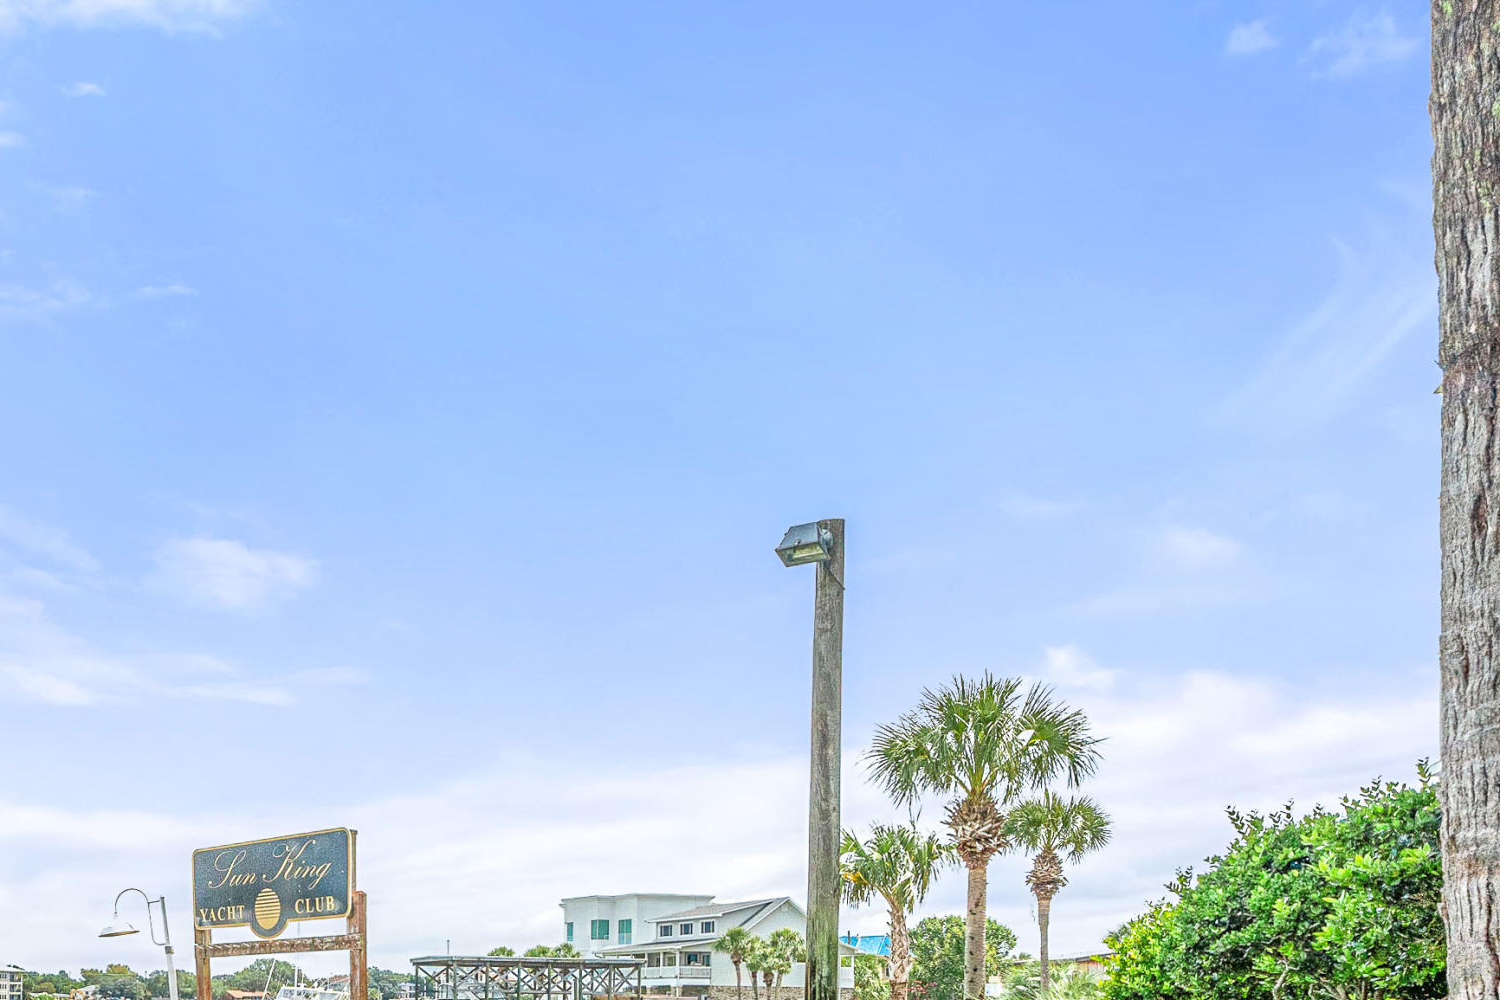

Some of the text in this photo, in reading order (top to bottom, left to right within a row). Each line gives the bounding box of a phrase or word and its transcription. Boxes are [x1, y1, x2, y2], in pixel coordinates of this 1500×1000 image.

[208, 839, 332, 890] Sun King
[200, 895, 335, 922] YACHT CLUB
